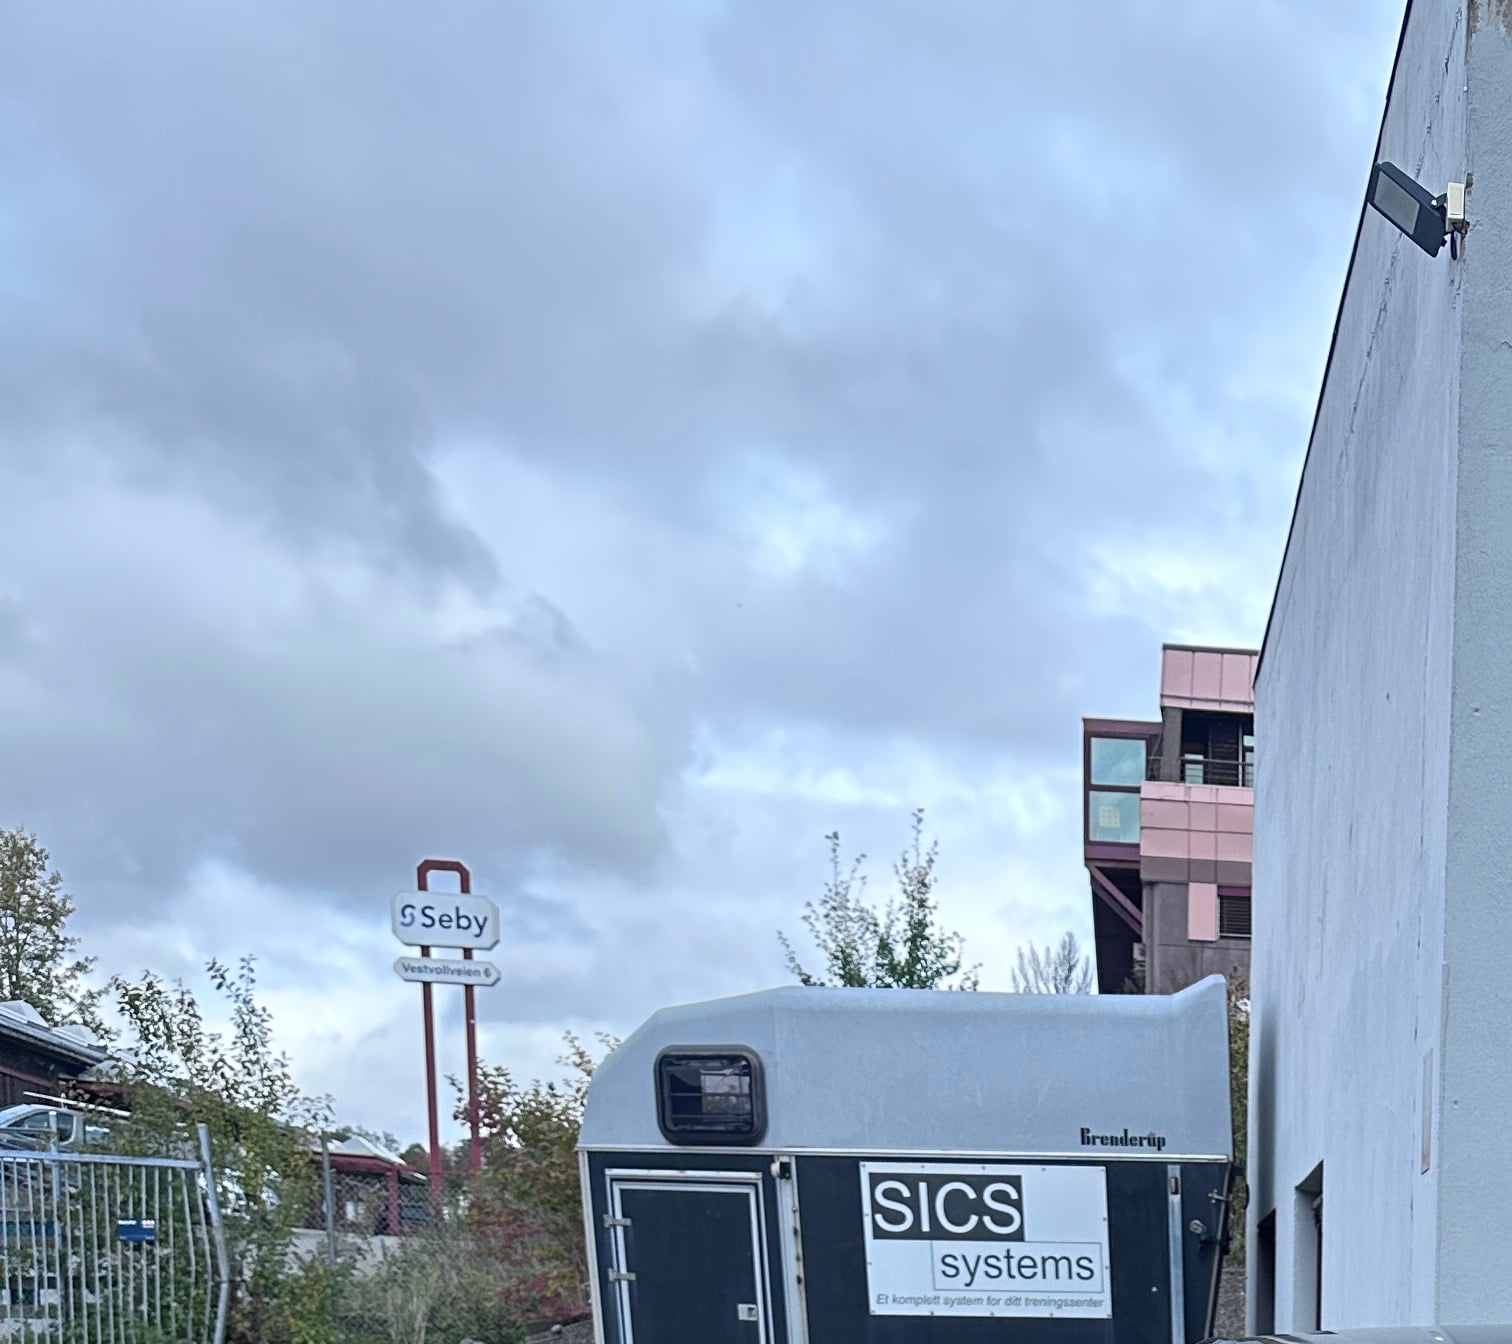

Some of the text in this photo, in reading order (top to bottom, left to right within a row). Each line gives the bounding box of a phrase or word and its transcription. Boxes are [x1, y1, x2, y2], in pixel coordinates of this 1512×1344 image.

[421, 905, 488, 938] Seby
[1080, 1127, 1166, 1151] Brenderup
[874, 1180, 1021, 1235] SICS
[941, 1248, 1095, 1287] systems
[892, 1294, 941, 1307] komplett
[943, 1295, 984, 1308] system
[986, 1295, 1002, 1307] for
[1004, 1295, 1022, 1307] ditt
[1024, 1297, 1104, 1310] treningssenter
